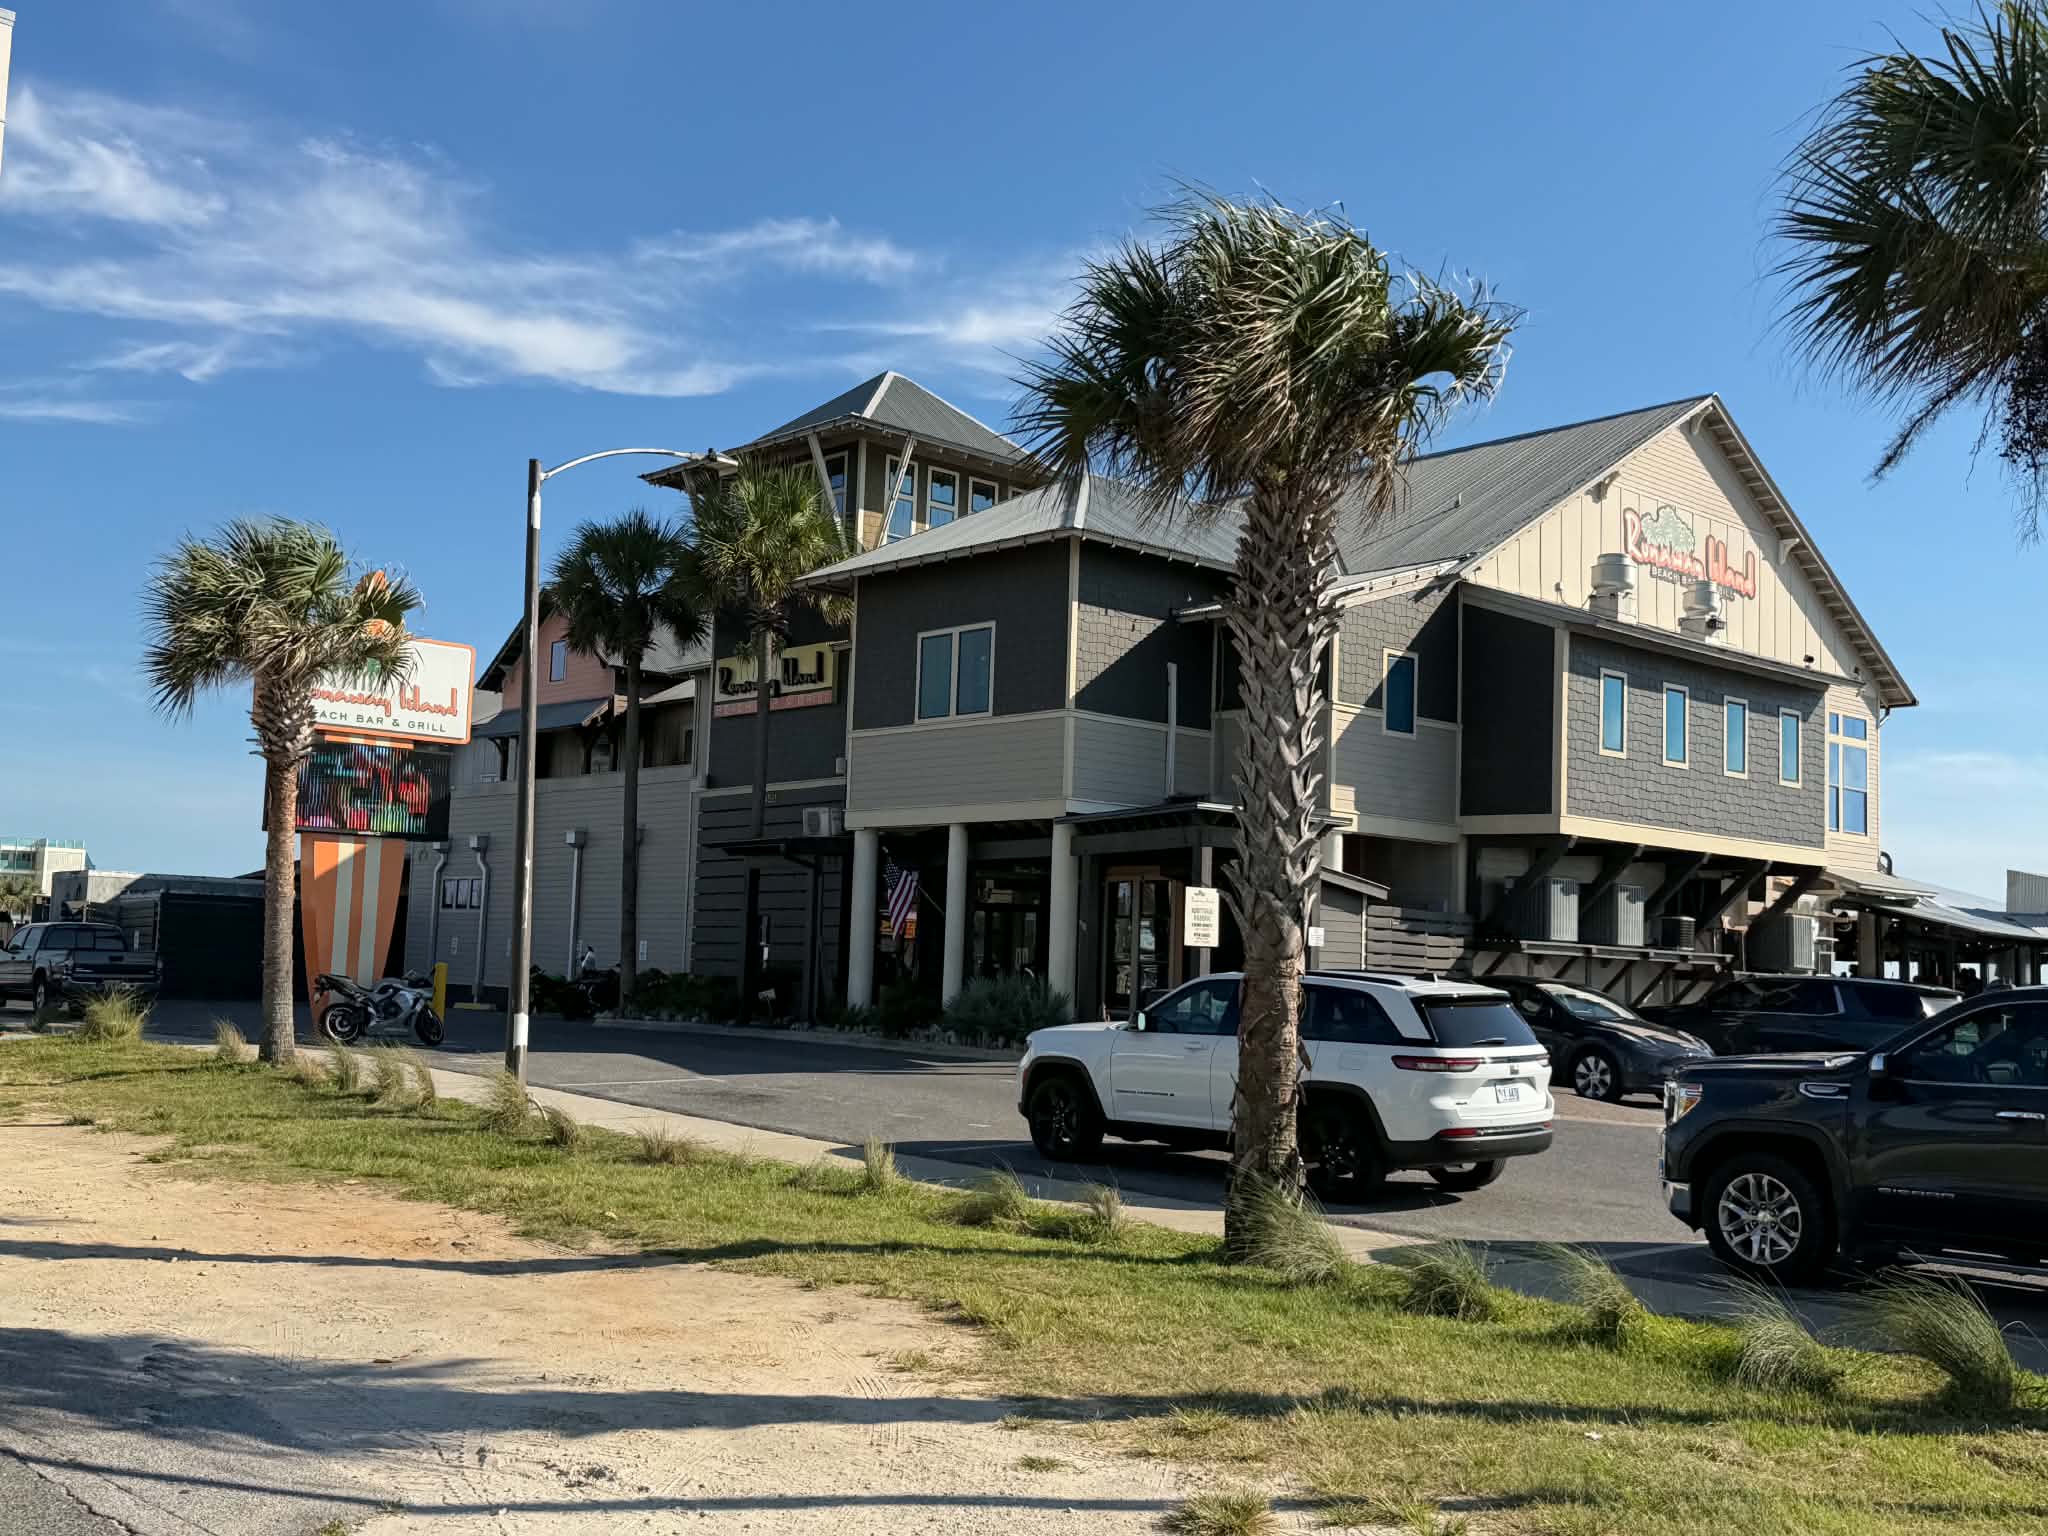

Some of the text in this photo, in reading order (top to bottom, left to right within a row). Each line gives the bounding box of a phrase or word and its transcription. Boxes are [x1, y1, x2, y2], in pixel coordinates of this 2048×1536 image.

[400, 684, 458, 717] Island
[356, 714, 384, 726] BAR
[391, 718, 400, 727] &
[407, 720, 447, 733] GRILL
